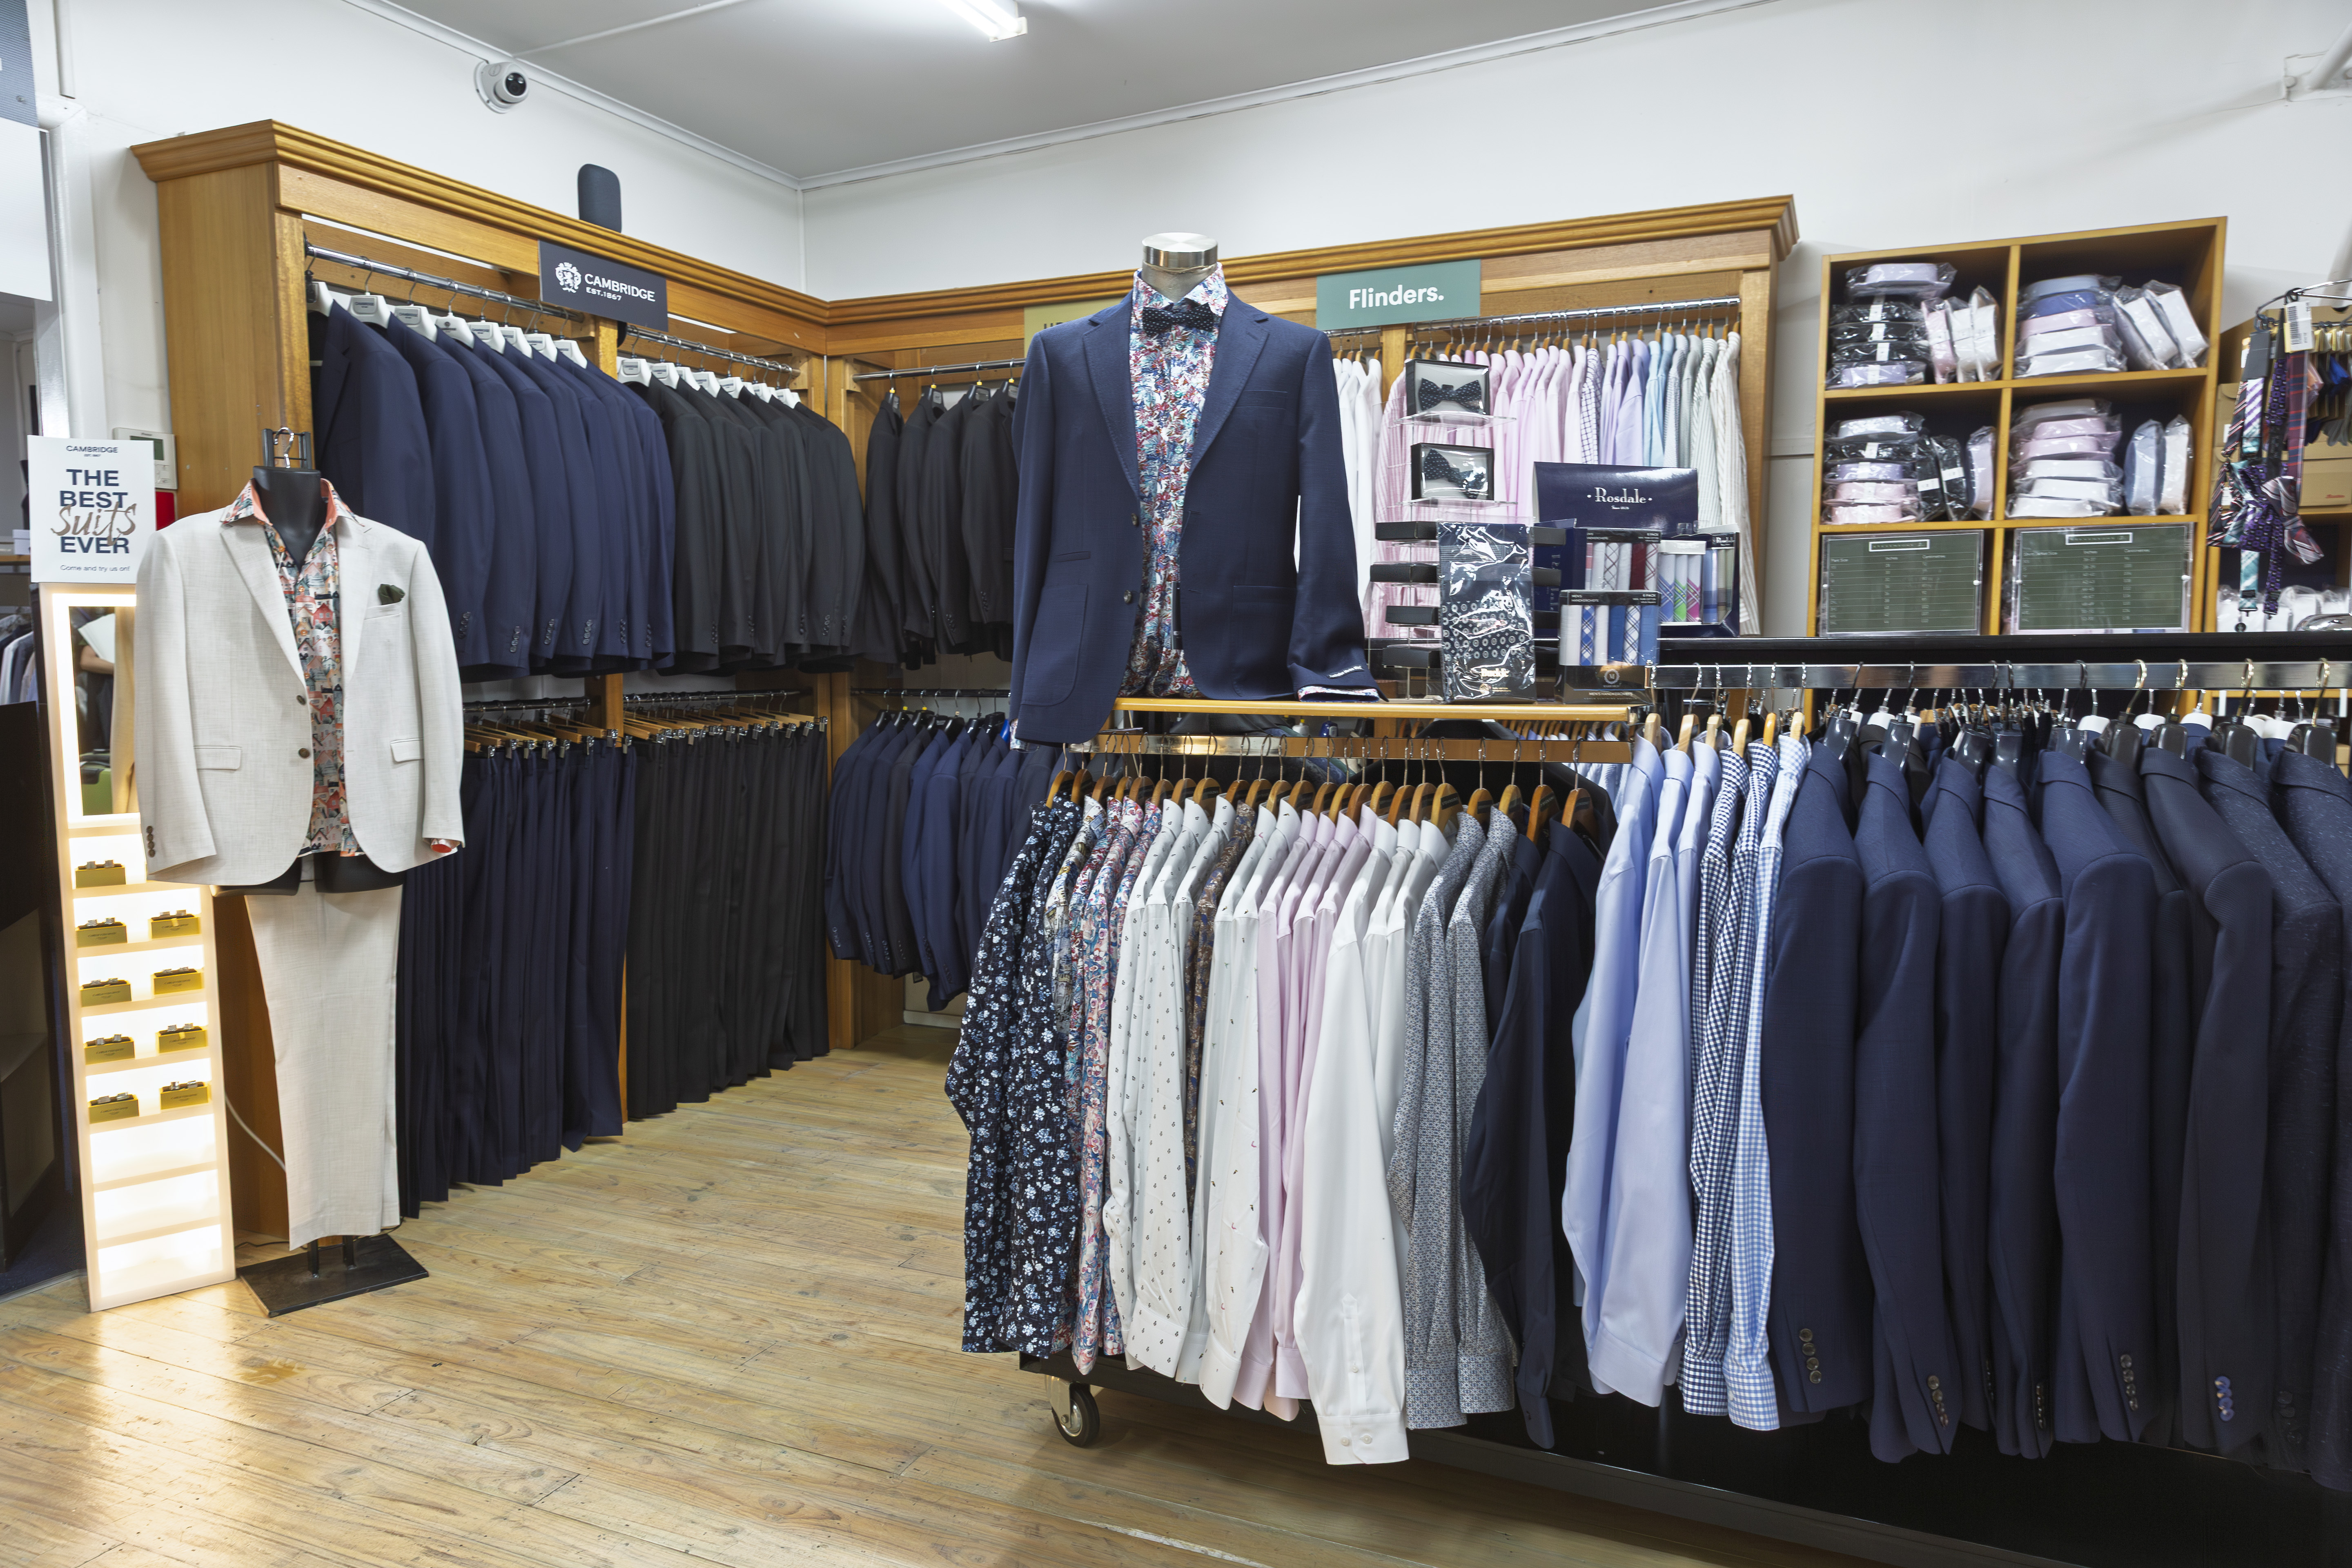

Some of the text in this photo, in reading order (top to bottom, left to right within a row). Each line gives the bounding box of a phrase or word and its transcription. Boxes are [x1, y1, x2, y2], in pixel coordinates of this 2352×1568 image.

[584, 274, 655, 302] CAMBRIDGE
[1349, 285, 1444, 310] Flinders.
[66, 469, 120, 486] THE
[60, 490, 128, 508] BEST
[1594, 487, 1646, 503] Rosdale
[60, 536, 129, 554] EVER
